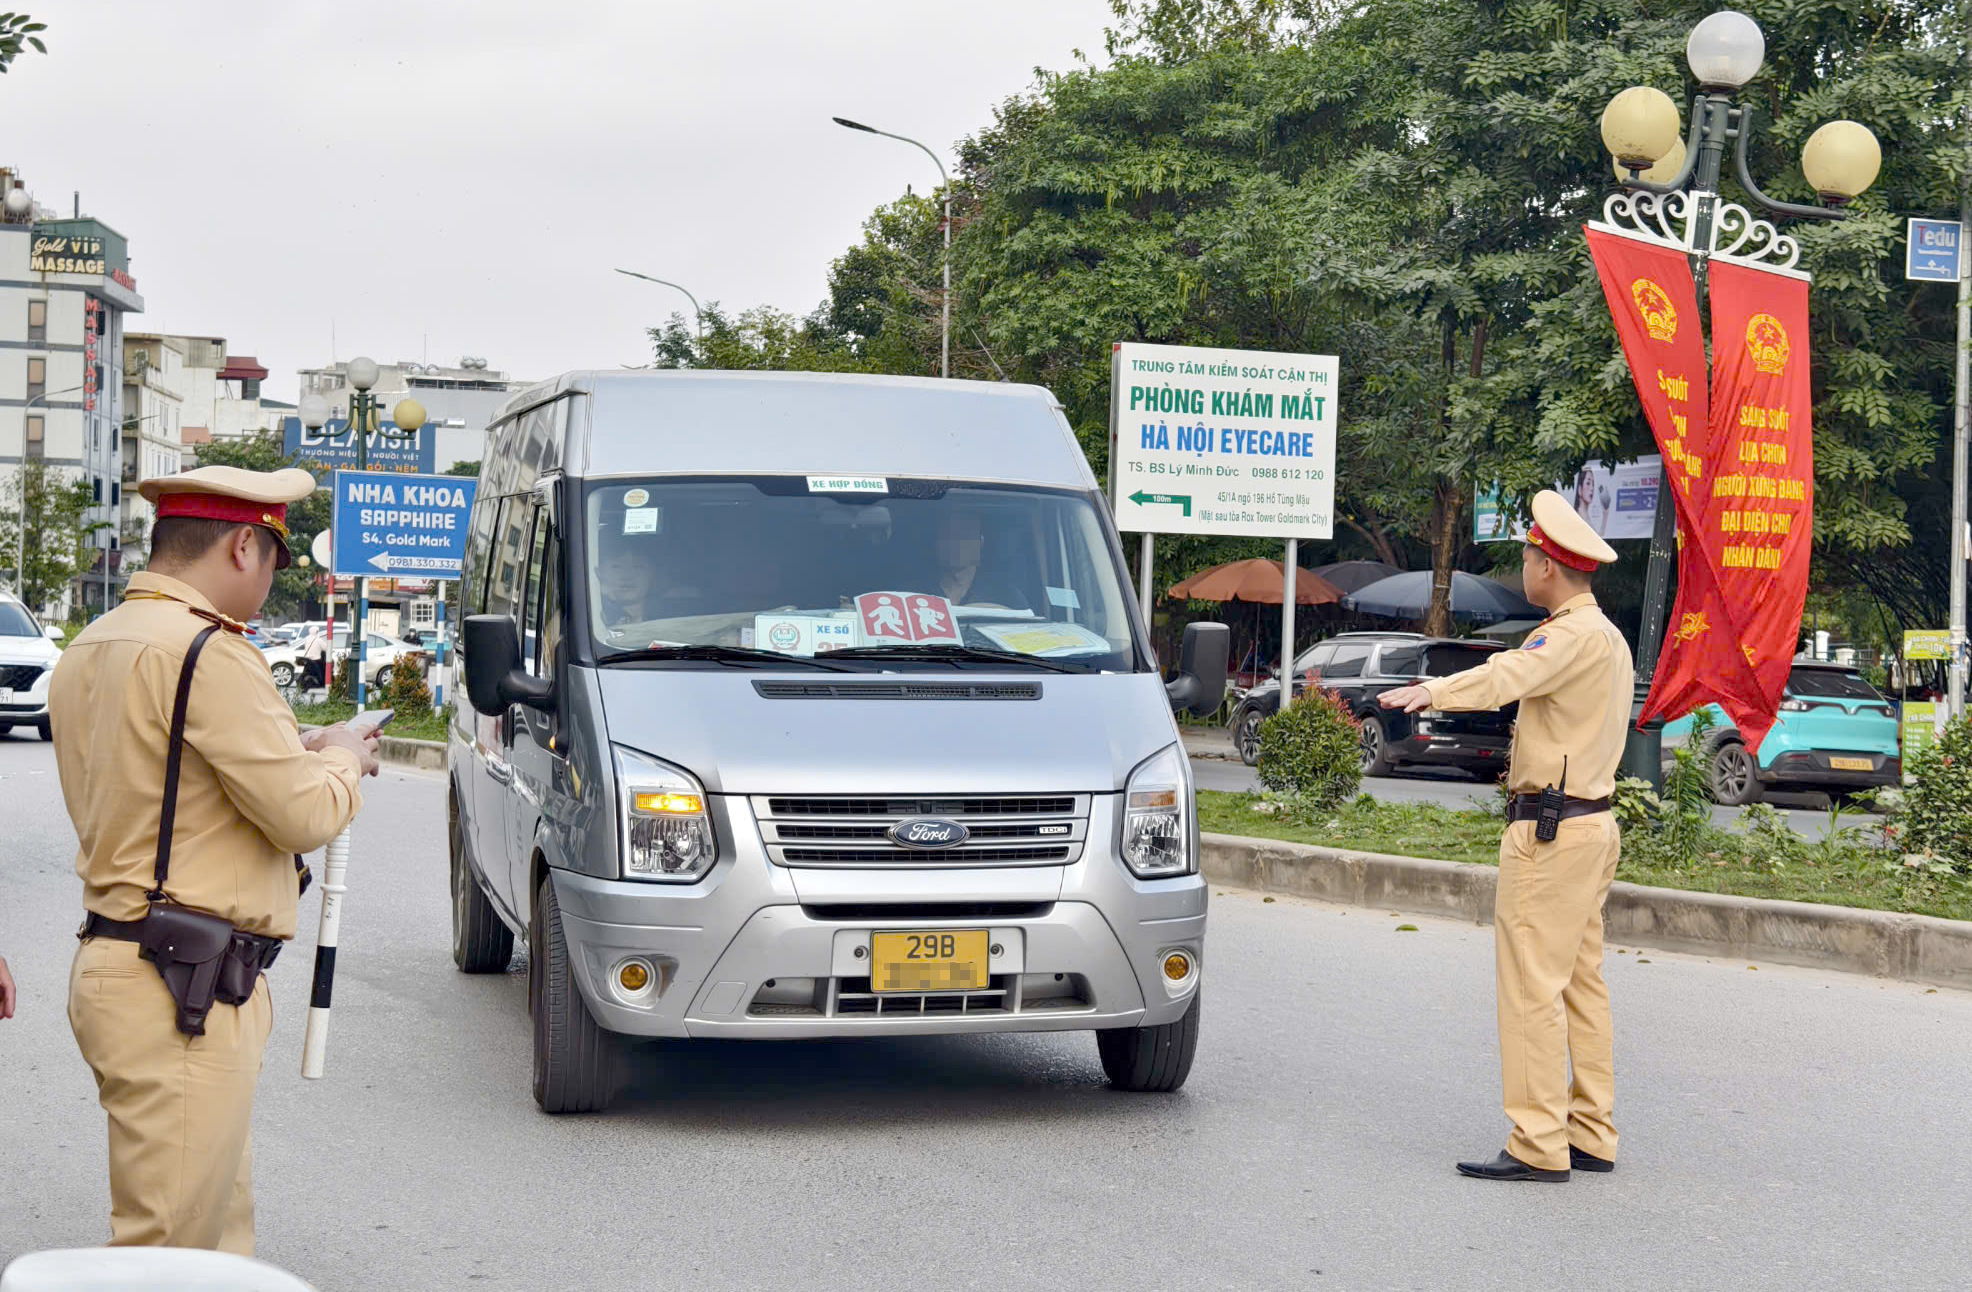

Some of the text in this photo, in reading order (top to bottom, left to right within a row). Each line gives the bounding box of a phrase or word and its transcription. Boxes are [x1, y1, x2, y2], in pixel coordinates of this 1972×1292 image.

[32, 237, 67, 256] Gold
[31, 256, 105, 274] MASSAGE
[85, 298, 98, 411] MASSAGE
[1132, 359, 1328, 386] TRUNG TÂM KIỂM SOÁT CẬN THỊ
[1130, 382, 1326, 421] PHÒNG KHÁM MẮT
[1739, 403, 1790, 432] SÁNG SUỐT
[1141, 419, 1313, 457] HÀ NỘI EYECARE
[1739, 440, 1787, 468] LỰA CHỌN
[1128, 461, 1324, 481] TS. BS Lý Minh Đức 0988 612 120
[812, 479, 884, 490] XE HỢP ĐỒNG
[1712, 471, 1746, 498] NGƯỜI
[1748, 473, 1777, 499] XỨNG
[1778, 477, 1805, 501] ĐÁNG
[348, 483, 467, 508] NHA KHOA
[1153, 494, 1172, 503] 100m
[1217, 491, 1237, 502] 45/1A
[1237, 493, 1252, 506] ngõ
[1277, 493, 1294, 507] Tùng
[1295, 494, 1310, 507] Mậu
[360, 509, 456, 530] SAPPHIRE
[1215, 512, 1227, 521] sau
[1241, 511, 1254, 522] Rox
[1256, 511, 1276, 523] Tower
[1277, 512, 1310, 524] Goldmark
[1312, 513, 1328, 526] City)
[1721, 508, 1792, 537] ĐẠI DIỆN CHO
[362, 532, 451, 548] S4. Gold Mark
[388, 557, 457, 569] 0981.330.332
[1722, 543, 1754, 568] NHÂN
[816, 623, 849, 635] XE SỐ
[908, 822, 951, 841] Ford
[906, 934, 955, 959] 29B
